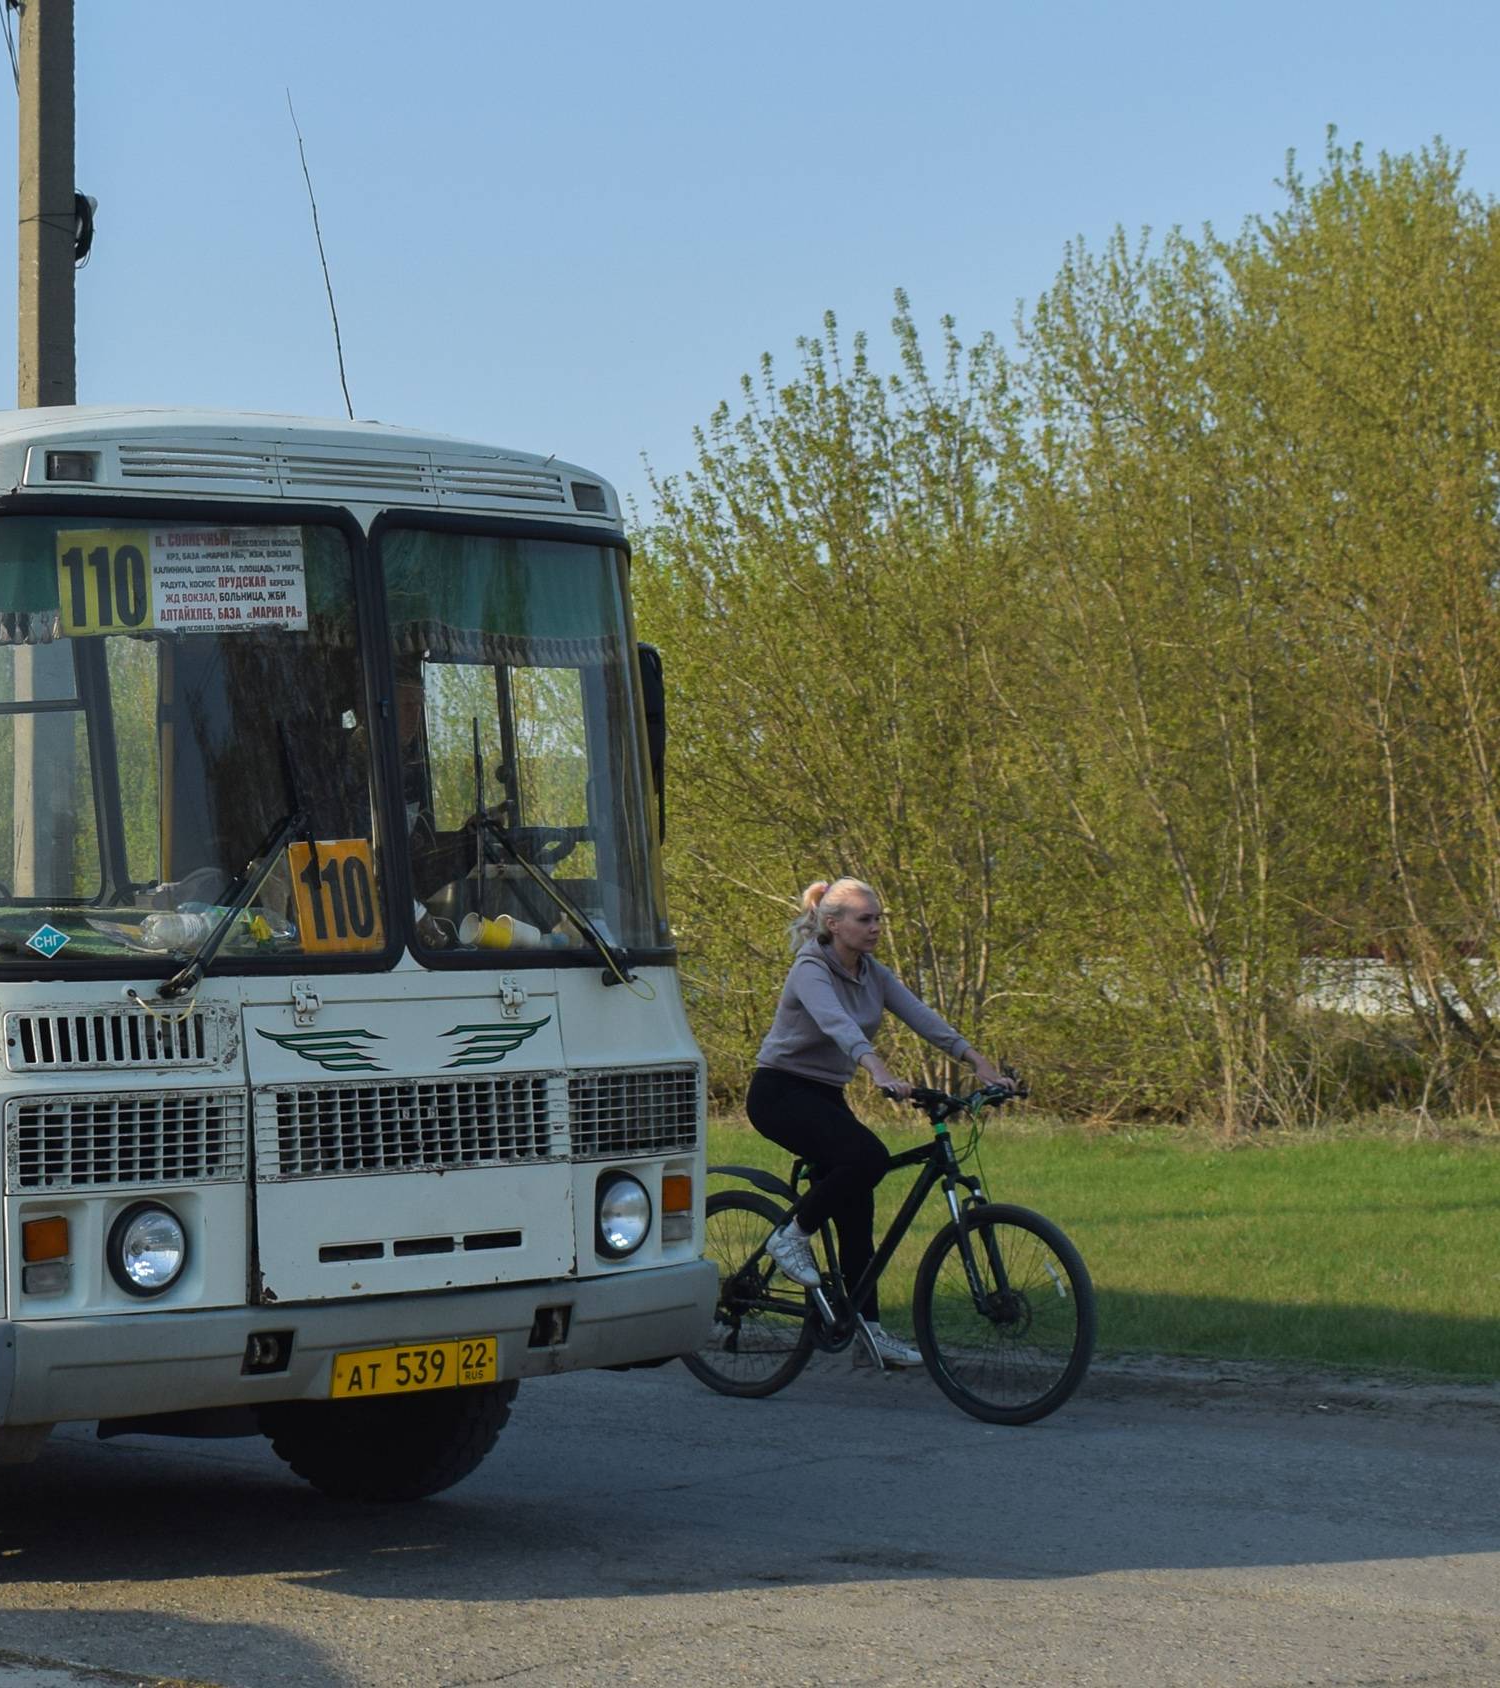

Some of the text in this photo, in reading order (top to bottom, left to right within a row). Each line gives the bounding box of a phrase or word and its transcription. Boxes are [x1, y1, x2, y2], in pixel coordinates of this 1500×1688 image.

[182, 552, 199, 560] БАЗА
[153, 566, 194, 574] КАЛИНИНА,
[62, 545, 147, 627] 110
[160, 581, 188, 590] РАДУГА,
[190, 581, 216, 589] КОСМОС
[218, 576, 266, 590] ПРУДСКАЯ
[165, 591, 286, 603] ЖД ВОКЗАЛ, БОЛЬНИЦА, ЖБИ
[160, 605, 302, 621] АЛТАЙХЛЕБ, БАЗА «МАРИЯ РА»
[300, 856, 374, 939] 110
[34, 934, 61, 948] СНГ
[461, 1342, 487, 1370] 22
[347, 1349, 445, 1392] АТ 539
[465, 1370, 485, 1380] RUS
